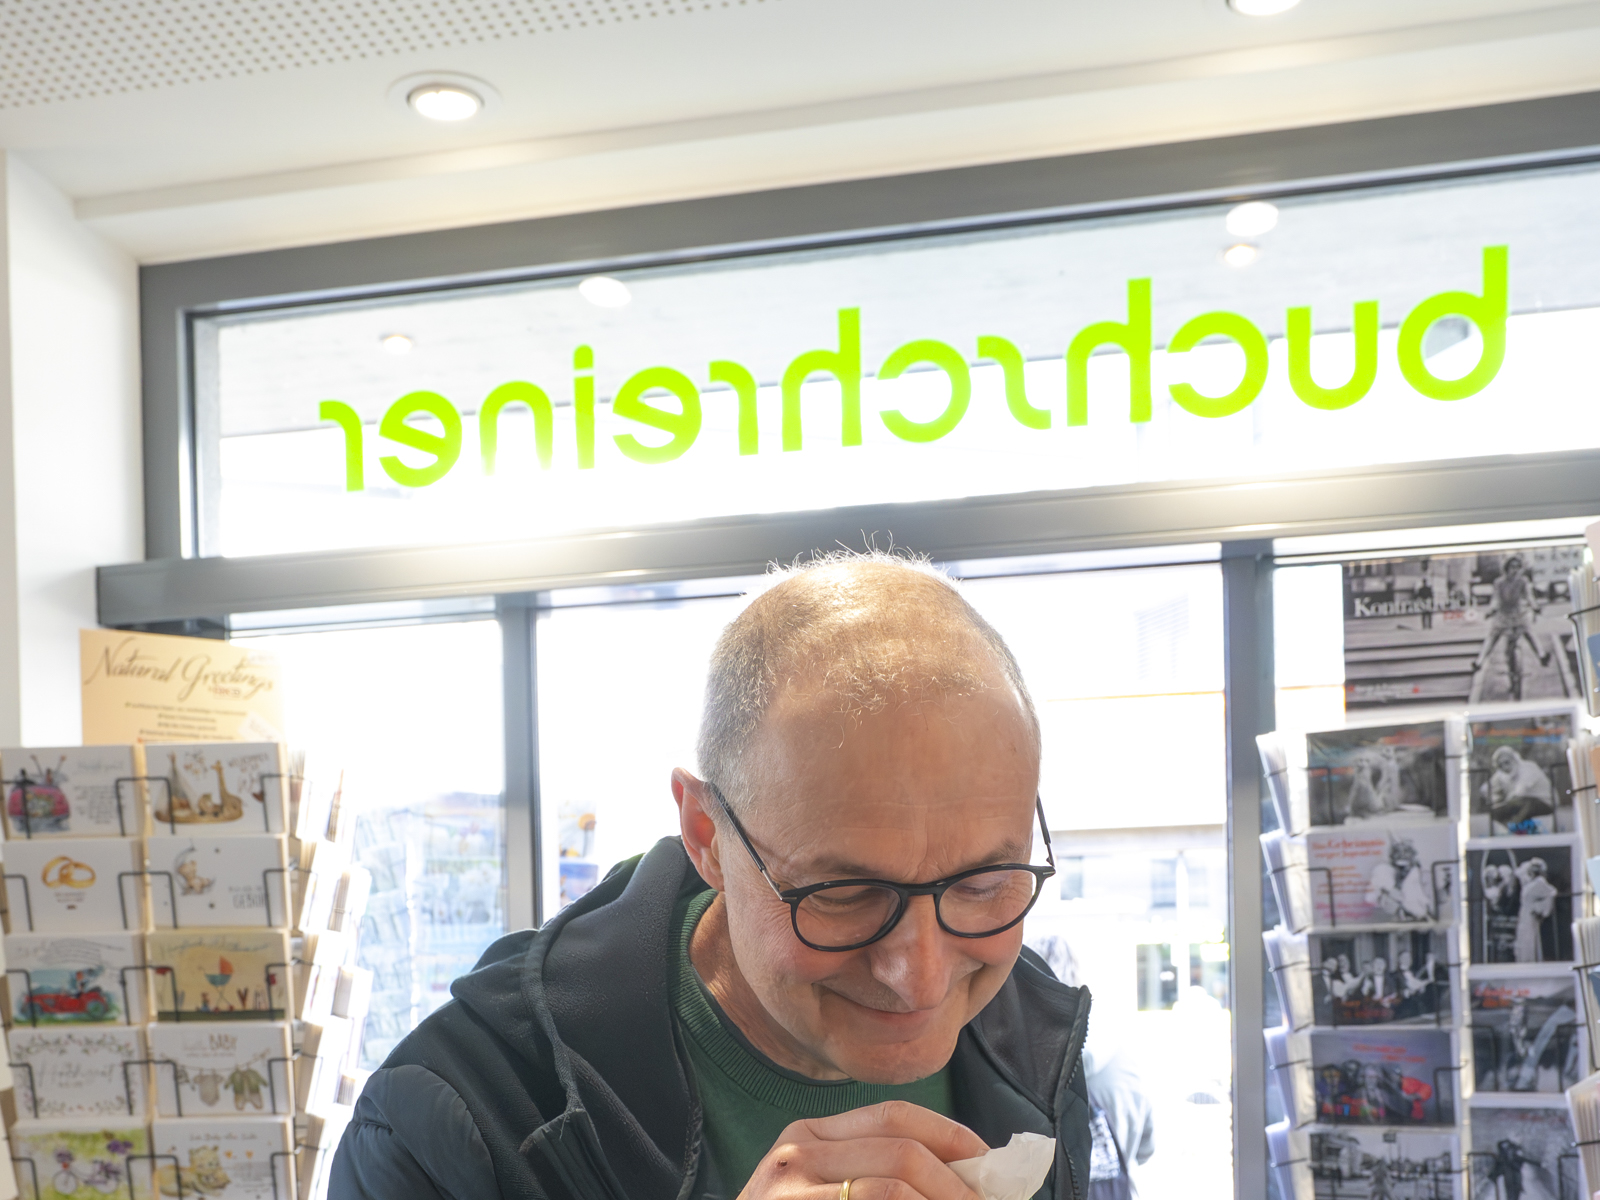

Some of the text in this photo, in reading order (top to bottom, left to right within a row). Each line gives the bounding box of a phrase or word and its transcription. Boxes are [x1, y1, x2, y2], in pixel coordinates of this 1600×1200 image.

[1353, 594, 1478, 618] Kontrastreich
[84, 637, 275, 702] Natural Greetings
